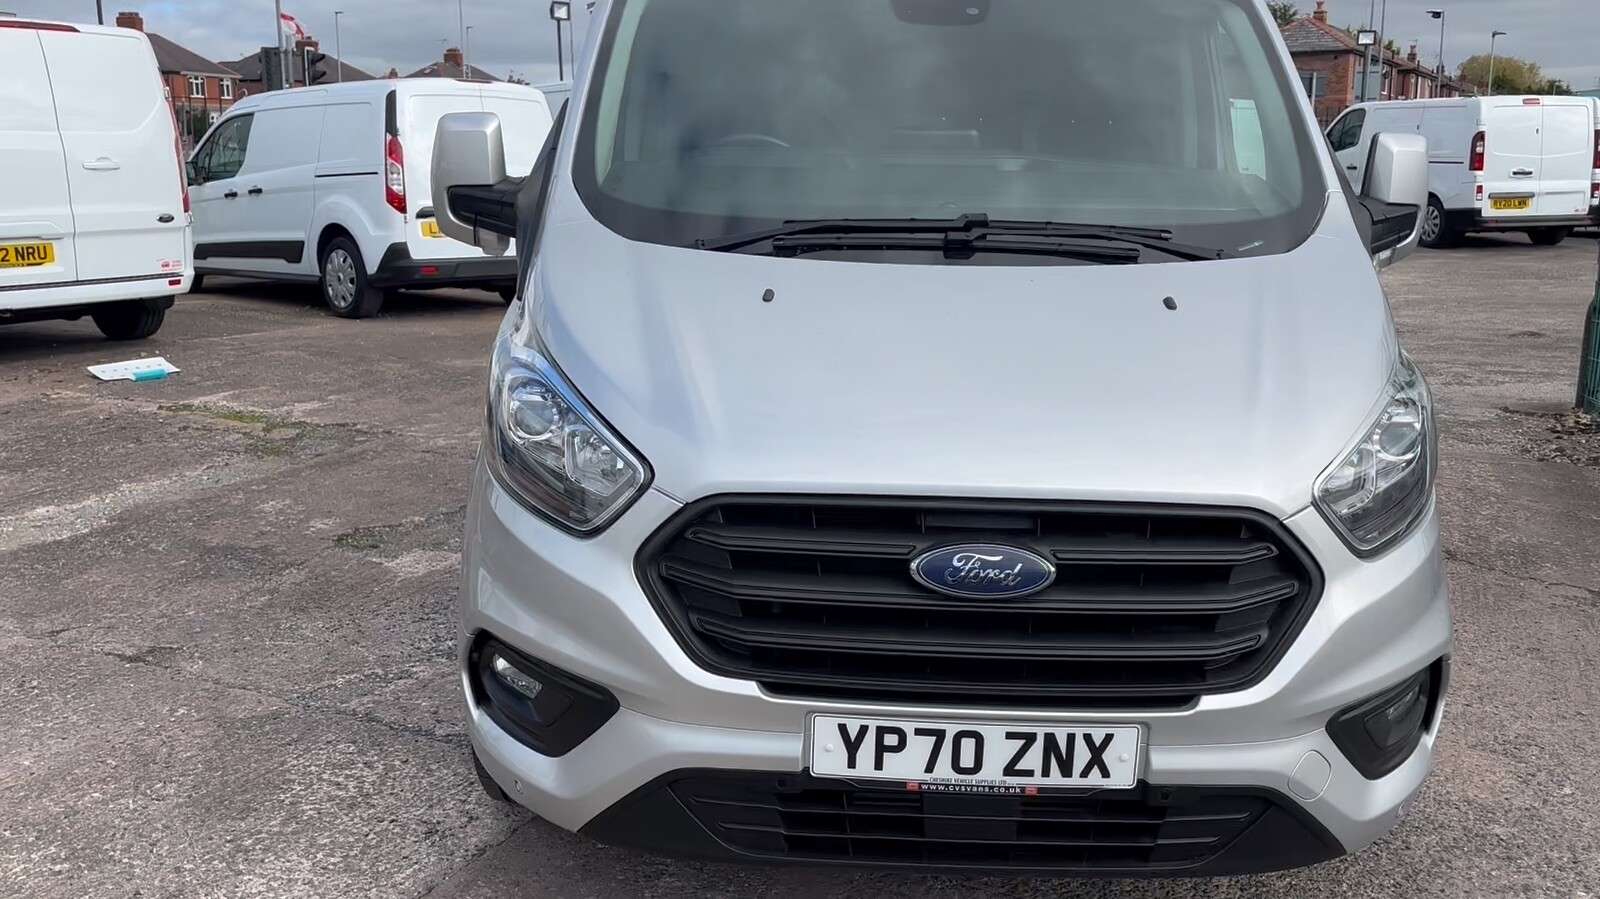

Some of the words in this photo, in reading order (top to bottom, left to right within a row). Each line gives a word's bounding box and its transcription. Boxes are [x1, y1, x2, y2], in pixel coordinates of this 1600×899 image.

[14, 245, 47, 261] NRU
[944, 552, 1023, 586] Ford
[837, 723, 985, 775] YP70
[1002, 731, 1114, 778] ZNX
[920, 784, 1021, 793] www.cvsvans.co.uk
